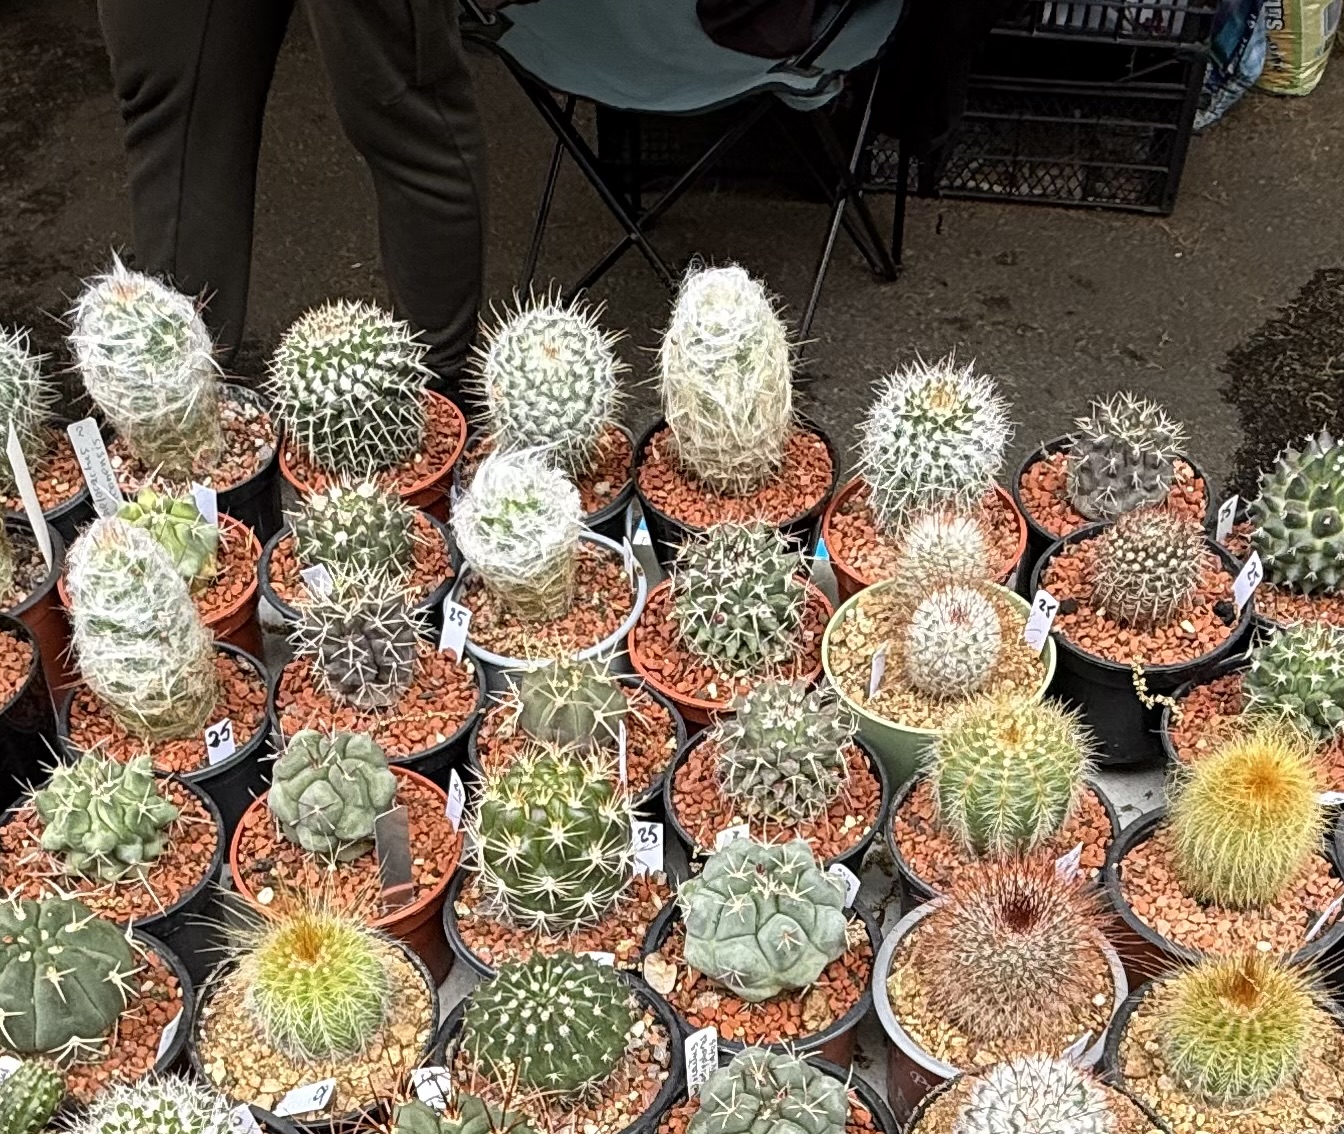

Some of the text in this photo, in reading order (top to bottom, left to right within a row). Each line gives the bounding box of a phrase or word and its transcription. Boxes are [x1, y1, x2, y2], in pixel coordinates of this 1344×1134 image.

[449, 607, 466, 626] 25
[1039, 598, 1056, 618] 25
[208, 721, 230, 747] 25
[638, 824, 658, 843] 25
